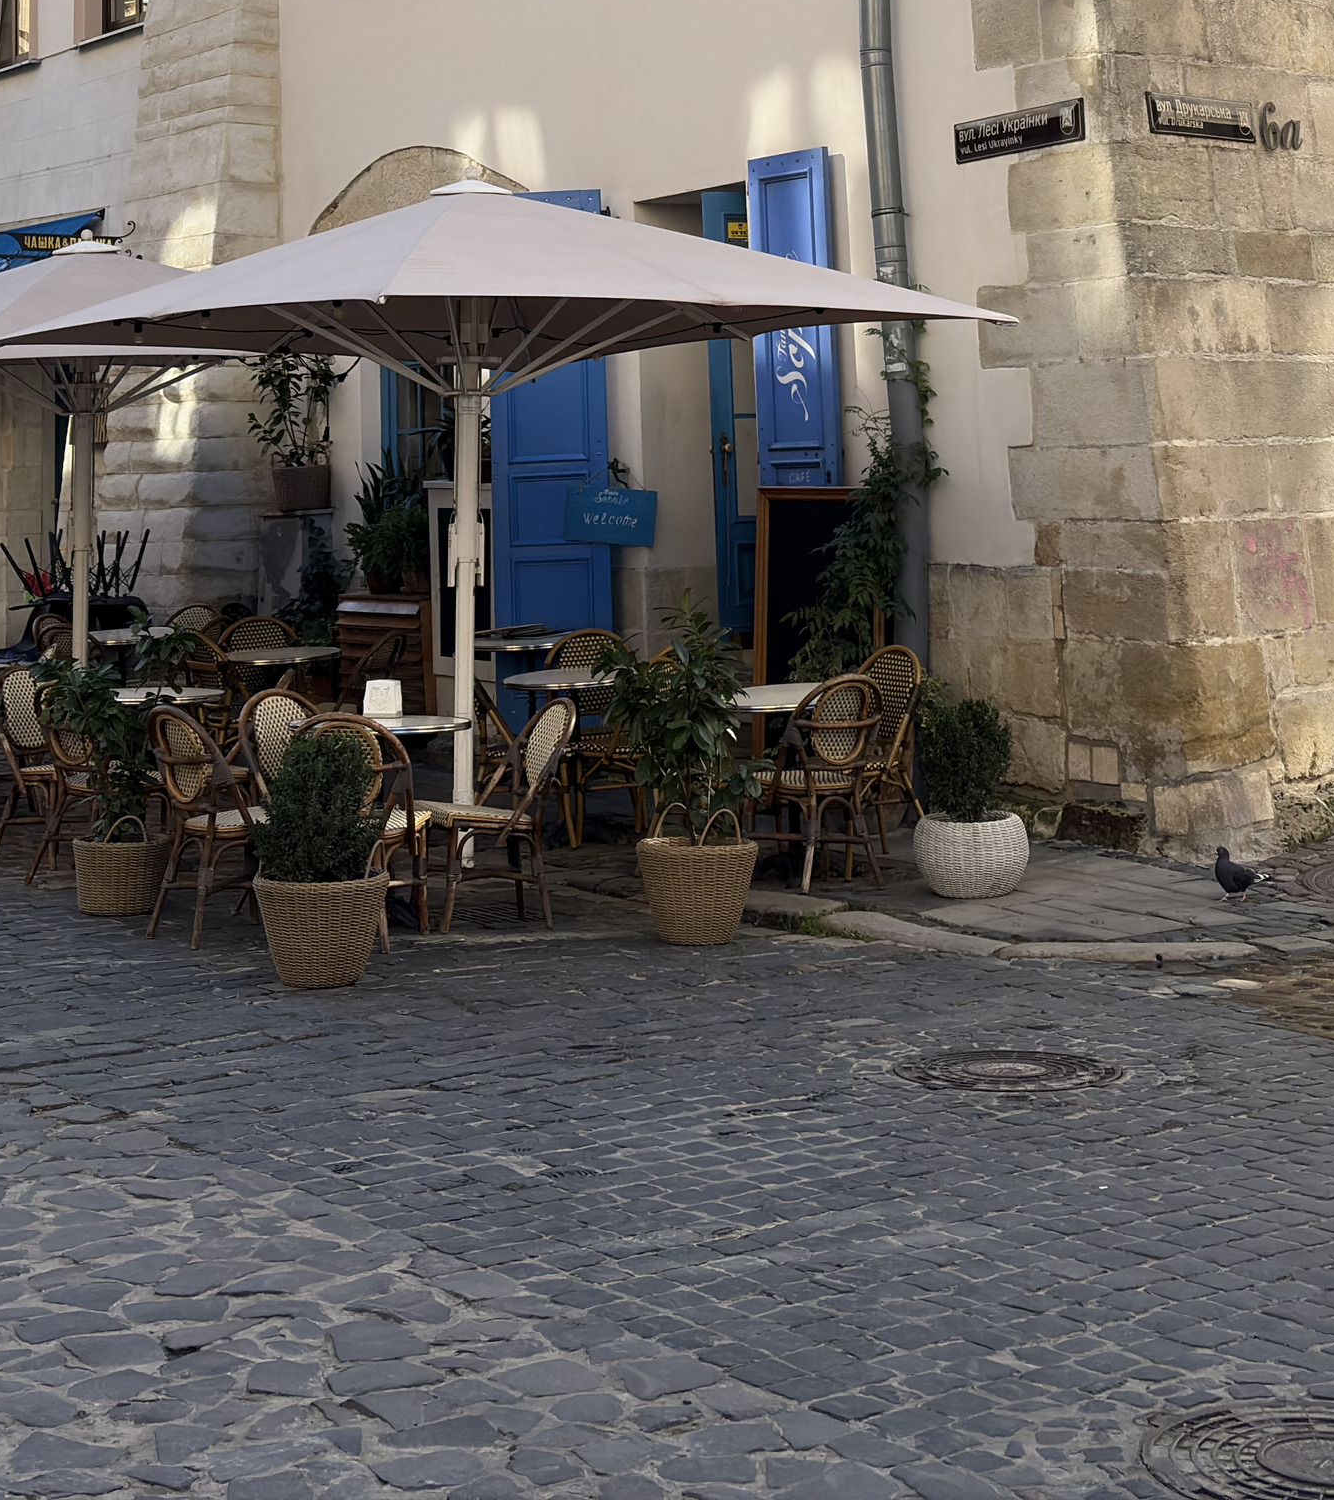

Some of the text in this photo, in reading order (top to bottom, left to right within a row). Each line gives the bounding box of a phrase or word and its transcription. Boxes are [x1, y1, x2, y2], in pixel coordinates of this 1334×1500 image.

[1155, 99, 1232, 120] вул. Друкарська
[959, 113, 1048, 143] вул. Лесі Українки
[959, 136, 1023, 155] vul. Lesi Ukrayinky
[788, 469, 811, 484] CAFÉ
[583, 512, 638, 528] Welcome
